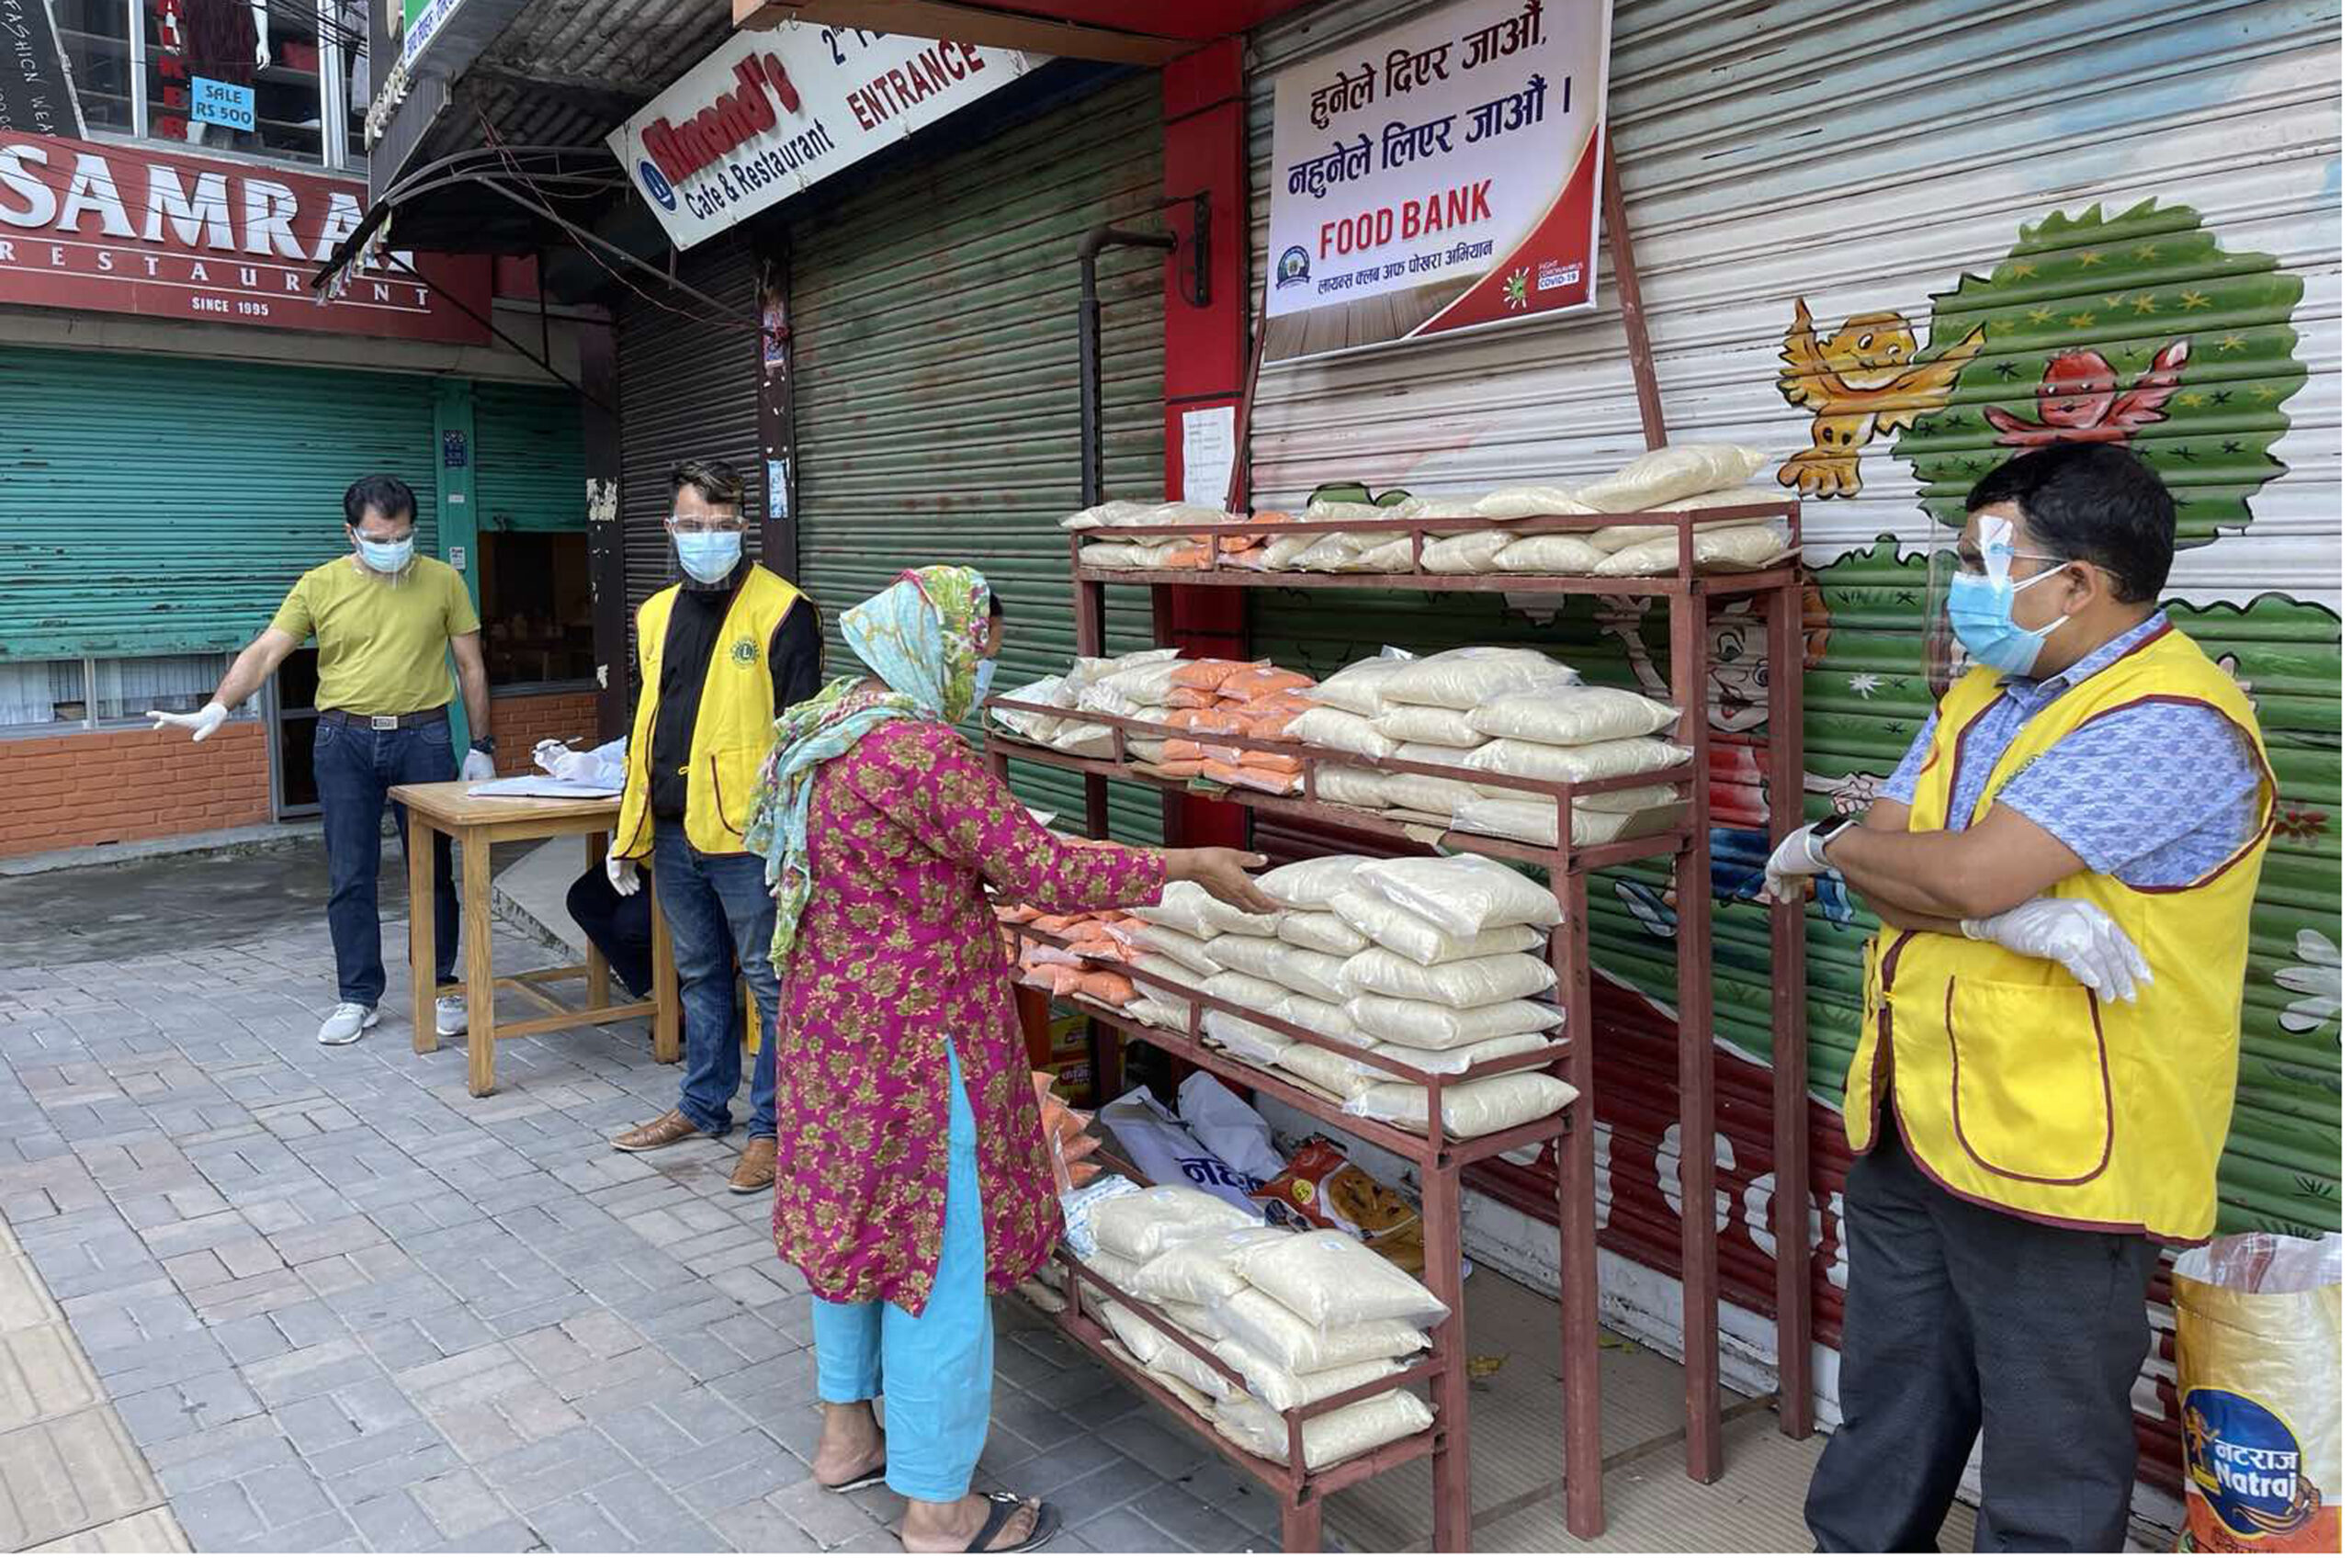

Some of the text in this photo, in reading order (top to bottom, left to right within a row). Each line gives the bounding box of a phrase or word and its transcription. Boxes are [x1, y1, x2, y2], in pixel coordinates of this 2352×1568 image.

[196, 102, 252, 124] RS 500
[205, 85, 242, 104] SALE
[846, 36, 986, 131] ENTRANCE
[1311, 63, 1377, 130] हुनेले
[1385, 43, 1453, 97] दिएर
[684, 117, 835, 220] Cafe & Restaurant
[1289, 133, 1373, 199] नहुनेले
[1382, 115, 1457, 170] लिएर
[0, 144, 417, 274] SAMRA
[1320, 179, 1492, 260] FOOD BANK
[0, 242, 429, 306] RESTAURNT
[1317, 272, 1353, 295] लायन्स
[1383, 260, 1406, 280] अफ
[1408, 254, 1442, 274] पोखरा
[1445, 239, 1494, 266] अभियान
[192, 297, 269, 316] SINCE 1995
[2214, 1438, 2299, 1471] नटराज
[2214, 1459, 2298, 1503] Natraj
